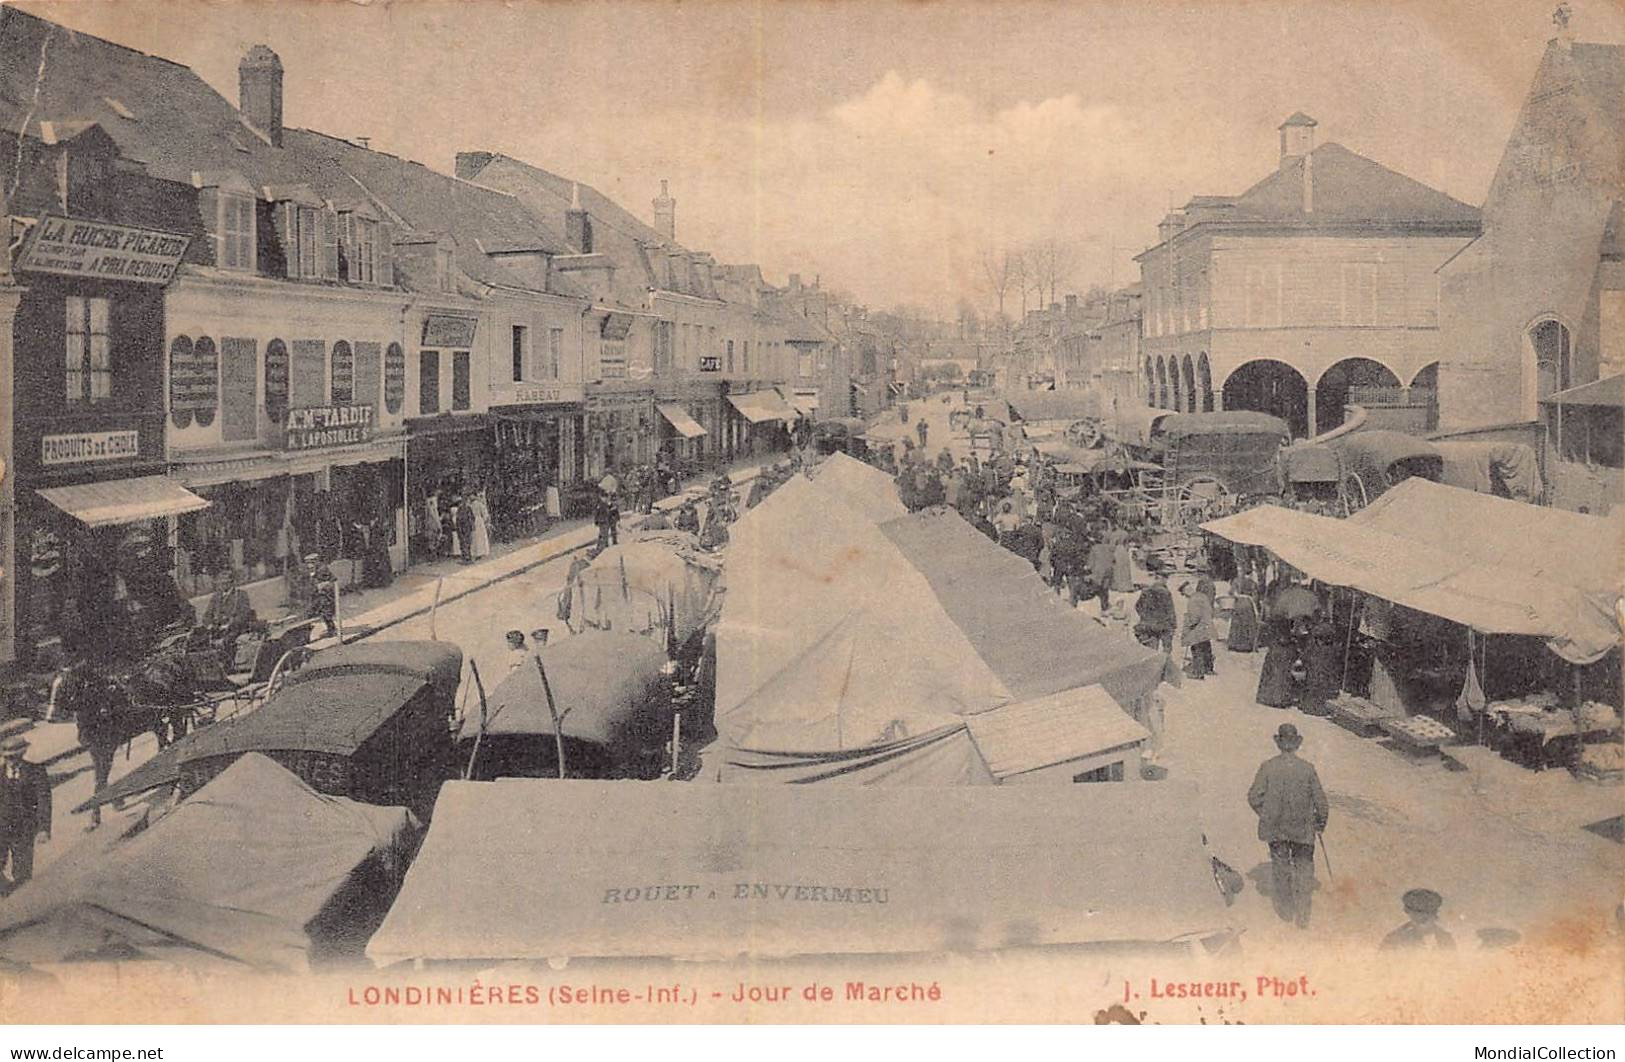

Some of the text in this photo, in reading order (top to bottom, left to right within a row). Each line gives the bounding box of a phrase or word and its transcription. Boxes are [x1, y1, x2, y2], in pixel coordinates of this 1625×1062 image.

[39, 221, 184, 257] LA RUCHE PICARDE
[100, 256, 126, 275] PRIX
[322, 406, 372, 427] TARDIF
[44, 437, 92, 460] PRODUITS
[108, 433, 137, 455] CHOIX
[301, 429, 359, 447] LAPOSTOLLE
[601, 885, 699, 904] ROUET
[734, 884, 890, 904] ENVERMEU
